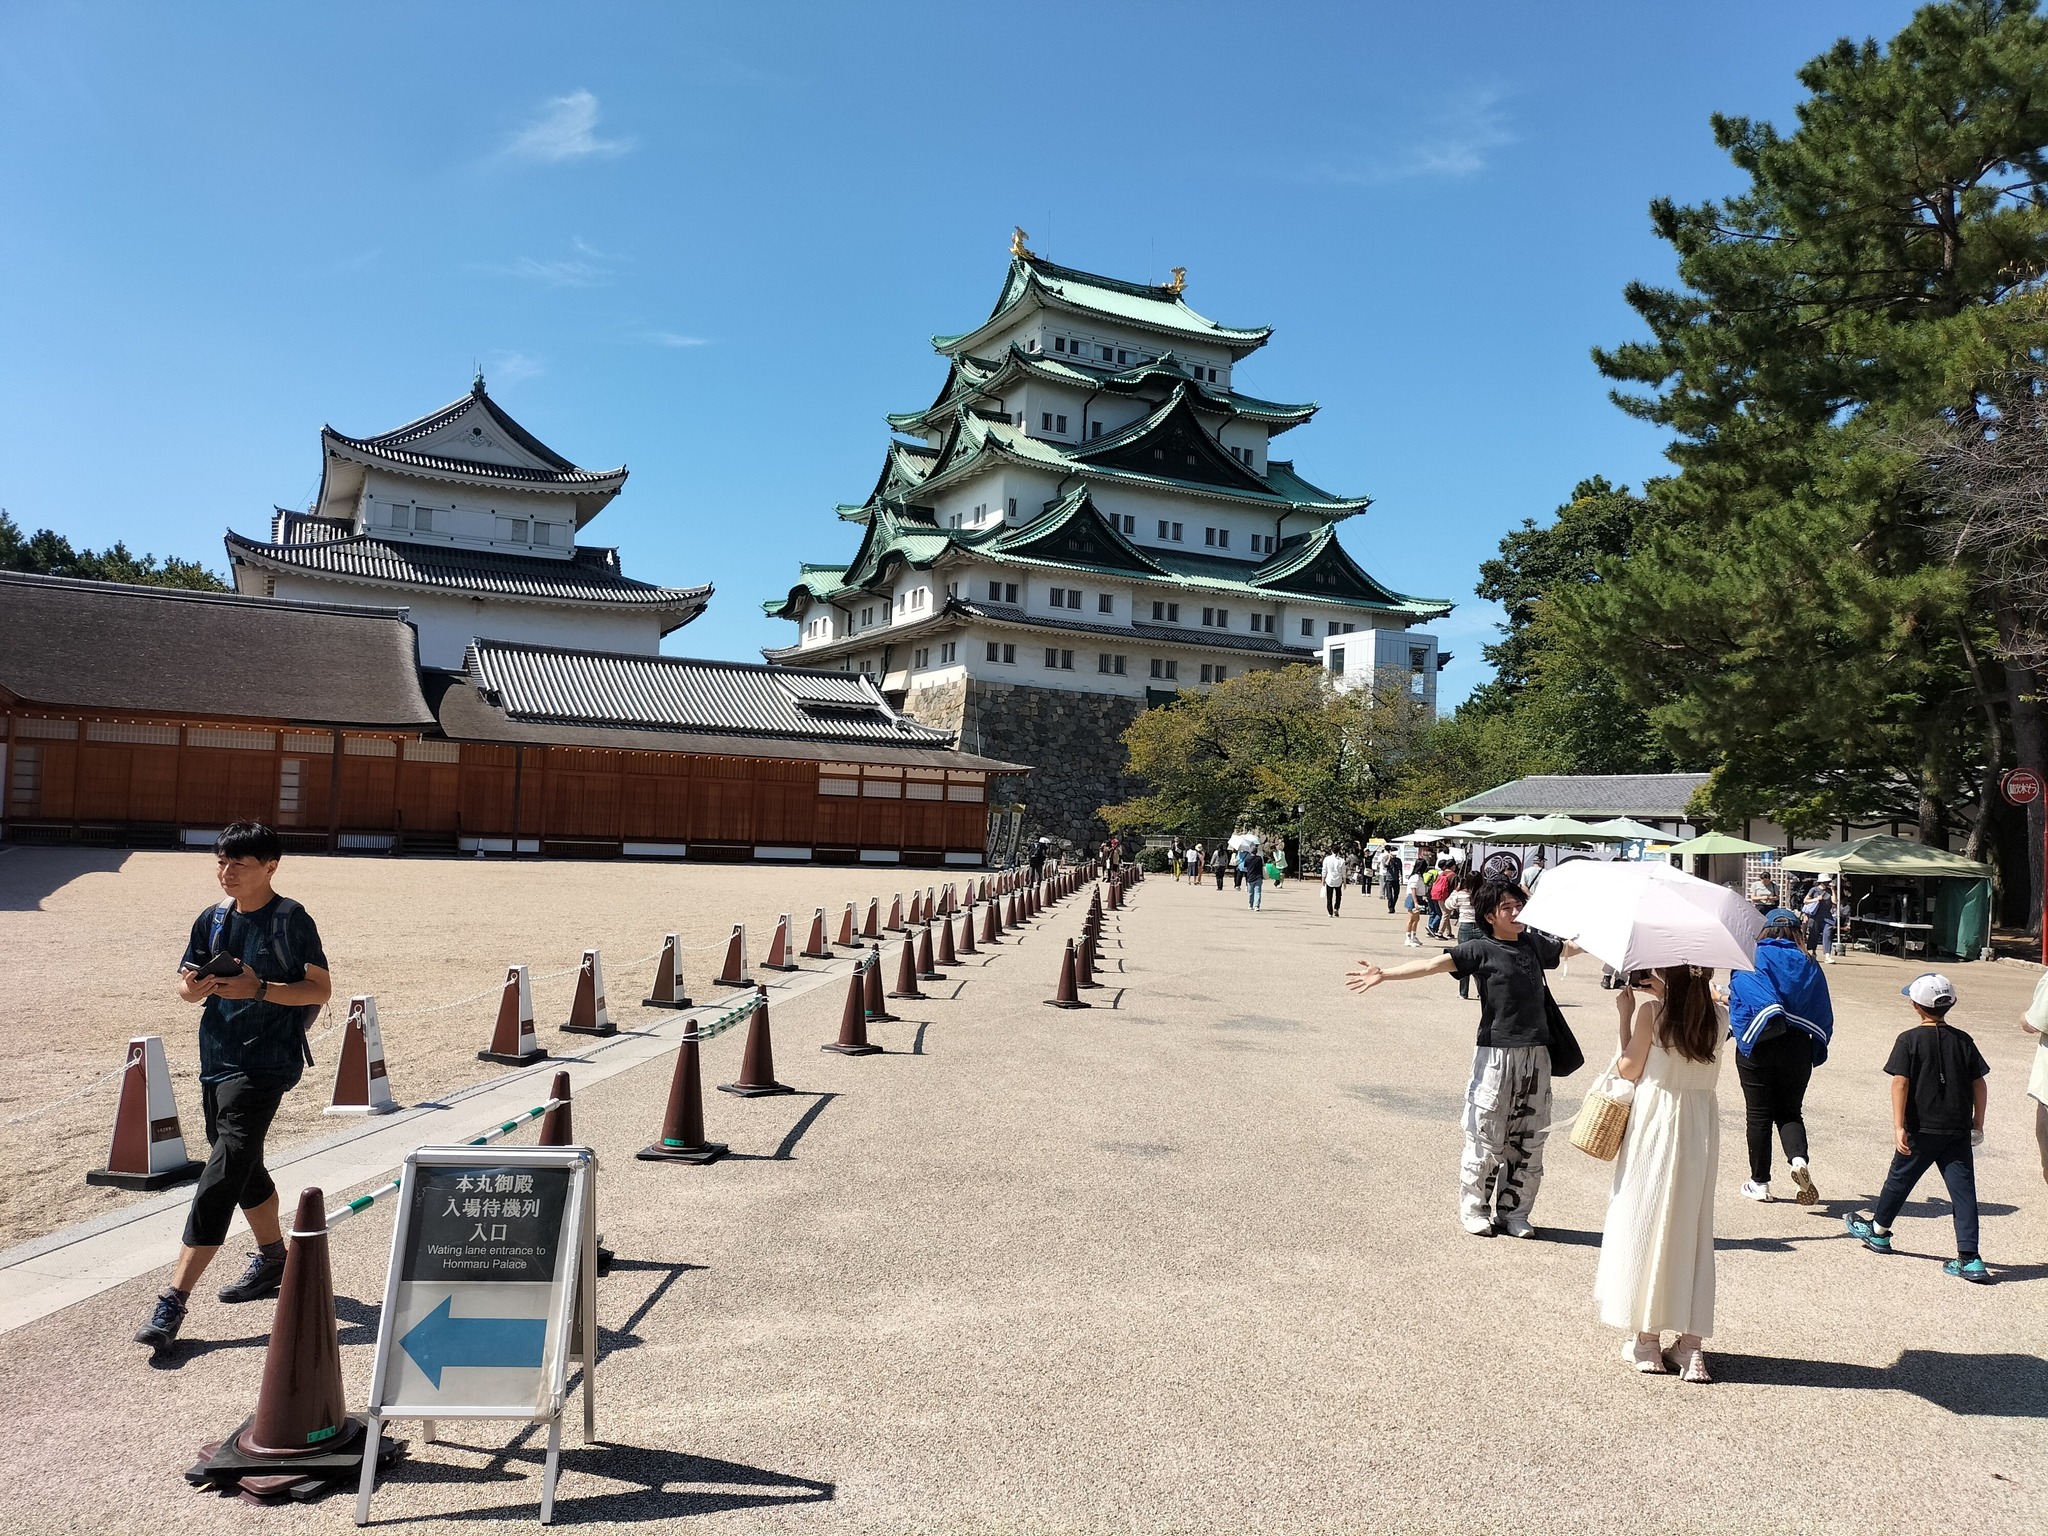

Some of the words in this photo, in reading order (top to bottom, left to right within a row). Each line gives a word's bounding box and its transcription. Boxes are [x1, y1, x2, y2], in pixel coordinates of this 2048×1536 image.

[455, 1174, 534, 1193] 本丸御殿
[442, 1197, 540, 1218] 入場待機列
[468, 1223, 508, 1242] 入口
[427, 1245, 463, 1257] Wating
[465, 1245, 487, 1255] lane
[489, 1245, 534, 1255] entrance
[536, 1245, 546, 1255] to
[443, 1258, 490, 1269] Honmaru
[492, 1259, 528, 1269] Palace
